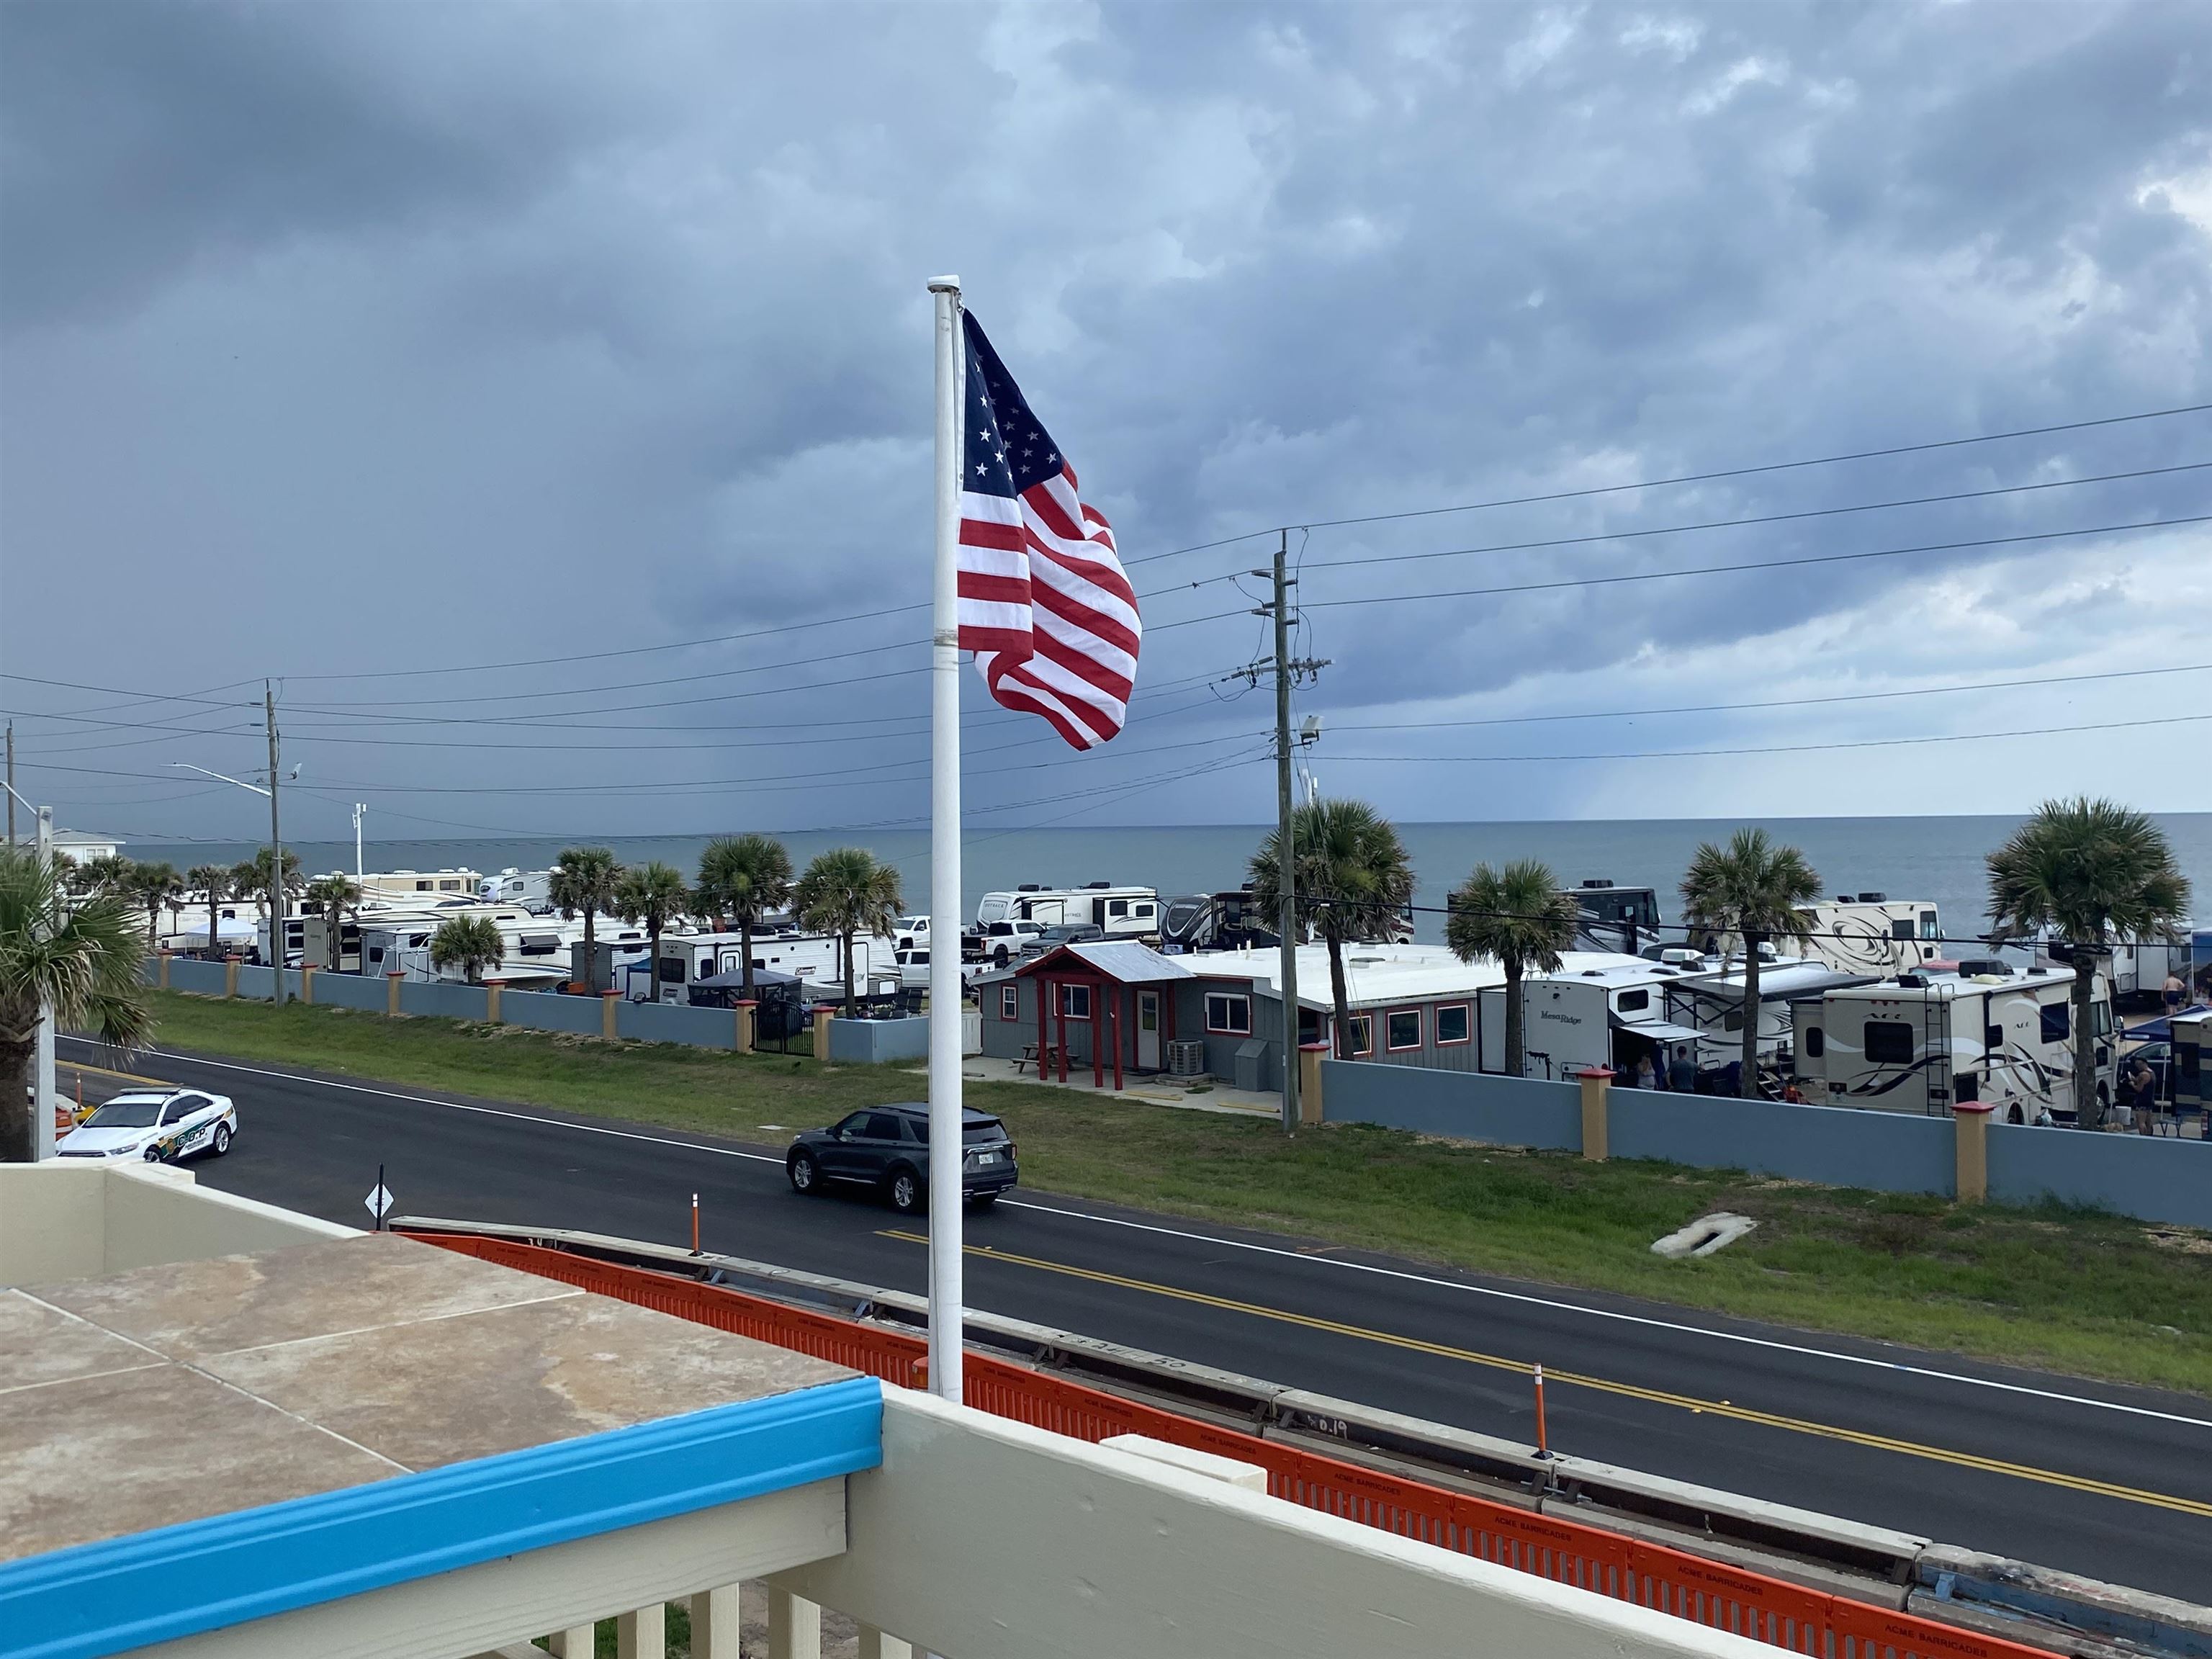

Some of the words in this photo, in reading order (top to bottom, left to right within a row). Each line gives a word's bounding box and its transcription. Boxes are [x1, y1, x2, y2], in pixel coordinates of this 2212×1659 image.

[1541, 1010, 1560, 1020] Mesa
[1560, 1014, 1582, 1025] Ridge
[1319, 1419, 1348, 1440] 0.19
[1495, 1516, 1517, 1527] ACME
[1520, 1522, 1571, 1541] BARRICADES
[1678, 1565, 1702, 1578] ACME
[1706, 1573, 1763, 1595] BARRICADES
[1885, 1624, 1915, 1638] ACME
[1919, 1633, 1987, 1658] BARRICADES
